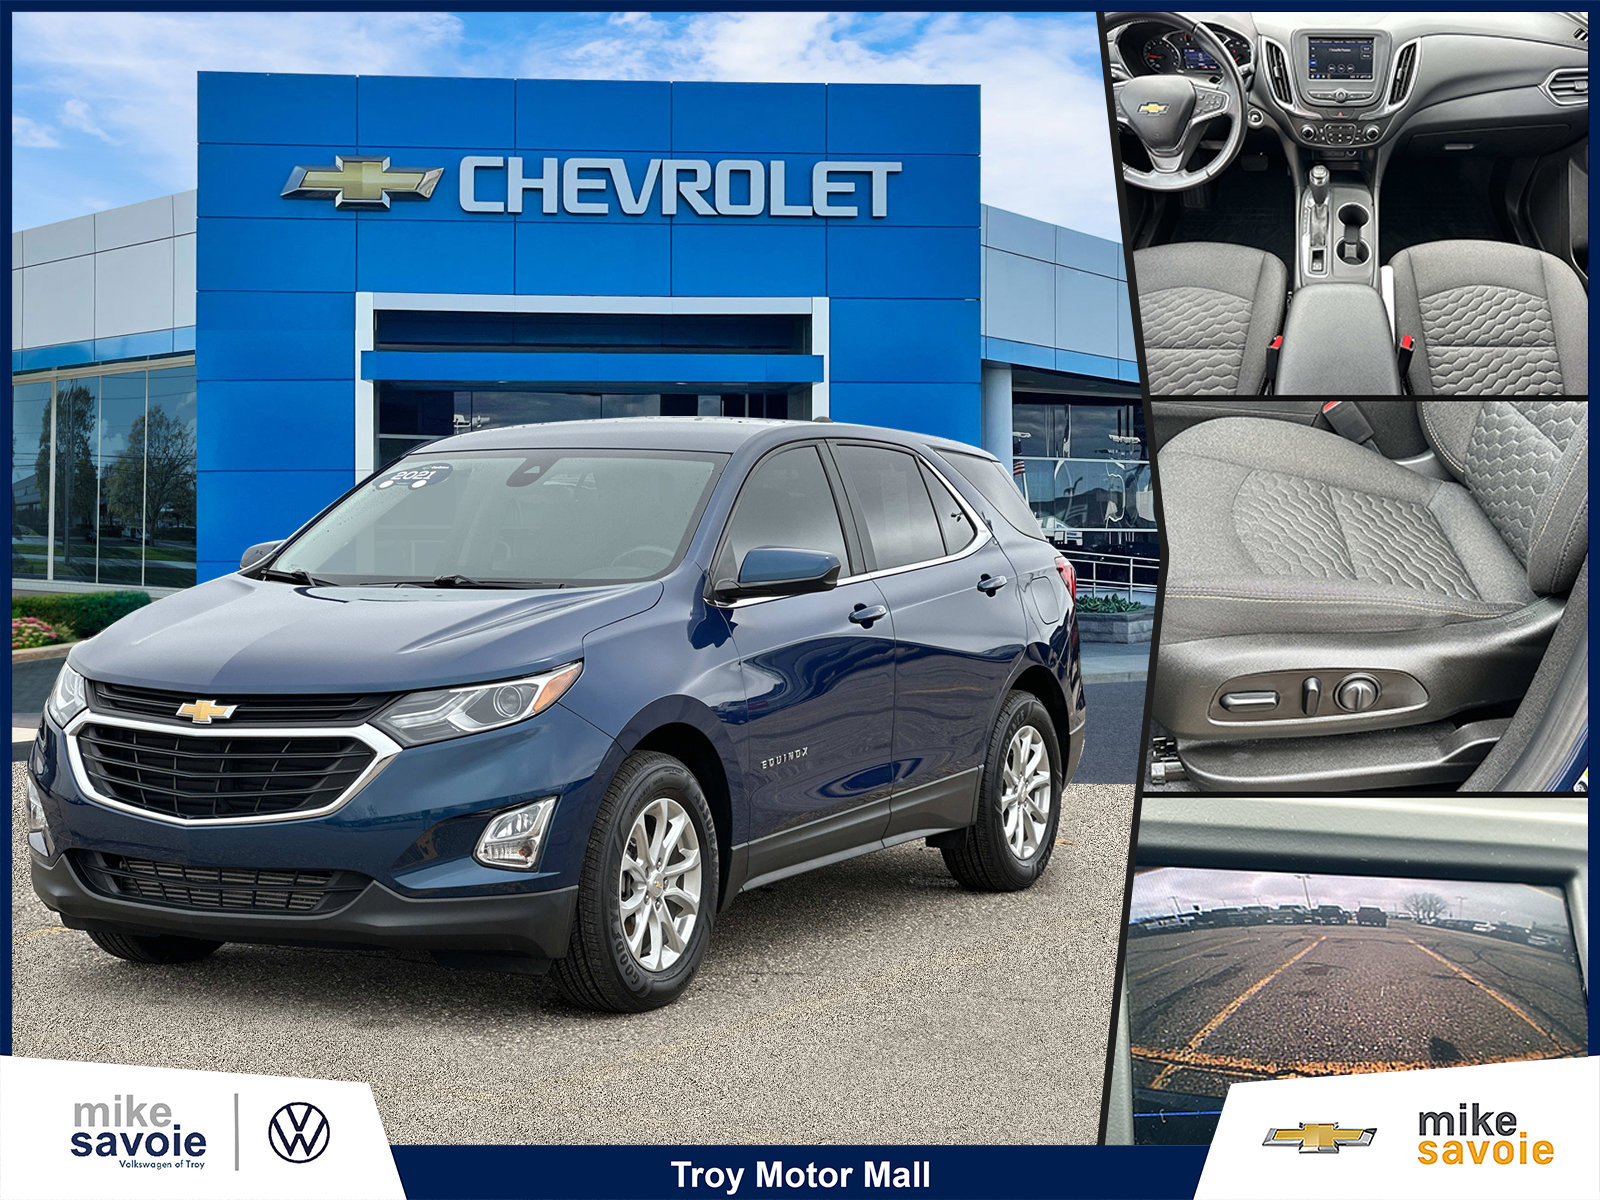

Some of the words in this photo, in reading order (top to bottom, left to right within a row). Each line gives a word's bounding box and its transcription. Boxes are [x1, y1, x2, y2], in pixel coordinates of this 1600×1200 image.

[459, 156, 902, 217] CHEVROLET
[391, 470, 436, 480] 2021
[761, 746, 808, 769] EQUINOX
